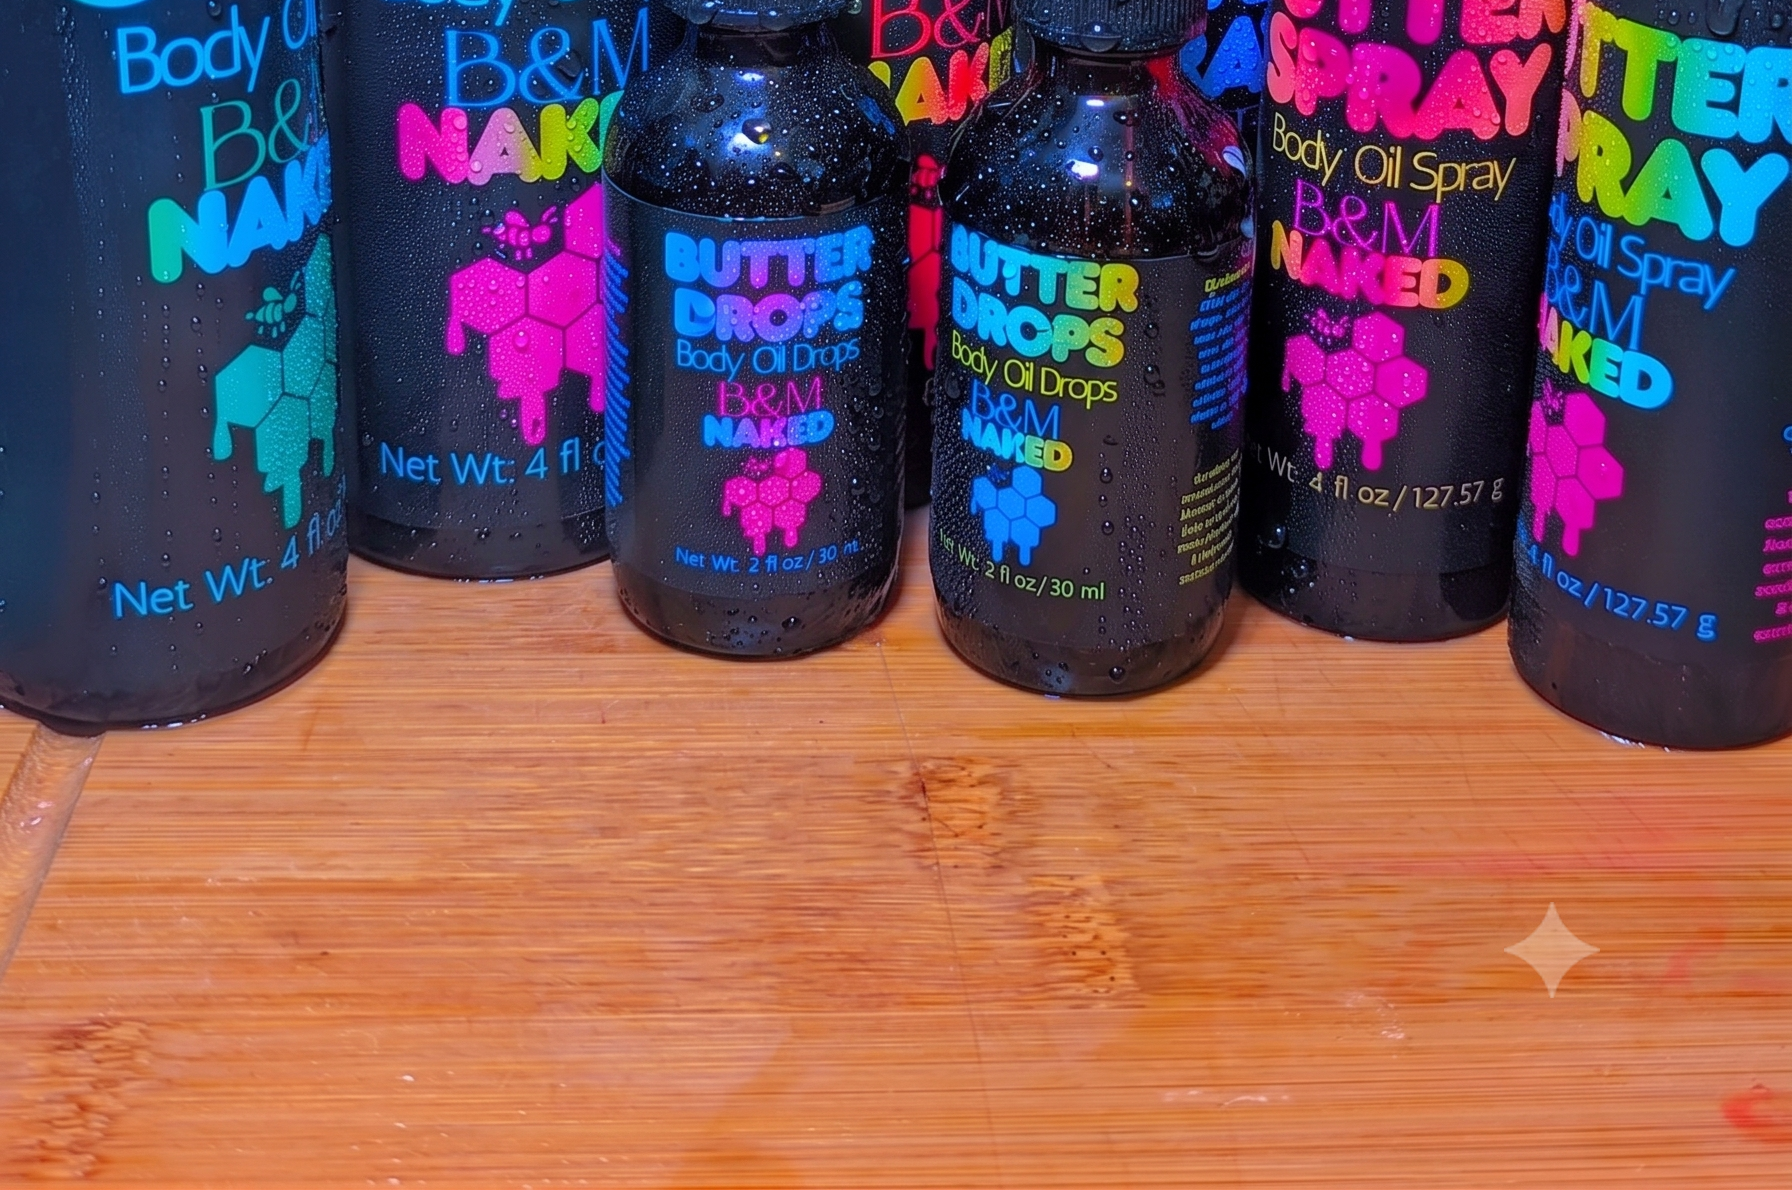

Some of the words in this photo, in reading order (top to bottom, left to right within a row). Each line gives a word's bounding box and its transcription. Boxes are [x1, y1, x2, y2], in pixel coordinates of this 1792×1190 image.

[116, 4, 270, 94] Body
[446, 8, 648, 107] B&M
[1267, 11, 1553, 140] SPRAY
[1272, 112, 1343, 186] Body
[1354, 144, 1402, 190] Oil
[1410, 156, 1516, 203] Spray
[1293, 178, 1440, 258] B&M
[666, 225, 874, 288] BUTTER
[951, 223, 1140, 312] BUTTER
[1271, 219, 1470, 309] NAKED
[1576, 217, 1613, 270] Oil
[1617, 235, 1736, 309] Spray
[674, 280, 864, 343] DROPS
[953, 276, 1125, 368] DROPS
[678, 339, 744, 382] Body
[752, 344, 786, 374] Oil
[793, 339, 861, 374] Drops
[952, 329, 998, 386] Body
[1004, 359, 1034, 392] Oil
[1041, 367, 1118, 409] Drops
[703, 410, 835, 448] NAKED
[719, 377, 824, 418] B&M
[971, 378, 1062, 439] B&M
[381, 442, 440, 483] Net
[525, 447, 547, 479] 4
[559, 437, 580, 474] fl
[962, 410, 1073, 472] NAKED
[1334, 474, 1348, 500] fl
[1491, 477, 1505, 501] g
[114, 580, 194, 618] Net
[281, 535, 300, 570] 4
[675, 546, 705, 568] Net
[749, 557, 760, 573] 2
[764, 554, 778, 572] fl
[985, 561, 995, 579] 2
[1000, 565, 1010, 584] fl
[1081, 582, 1105, 600] ml
[1696, 613, 1717, 640] g
